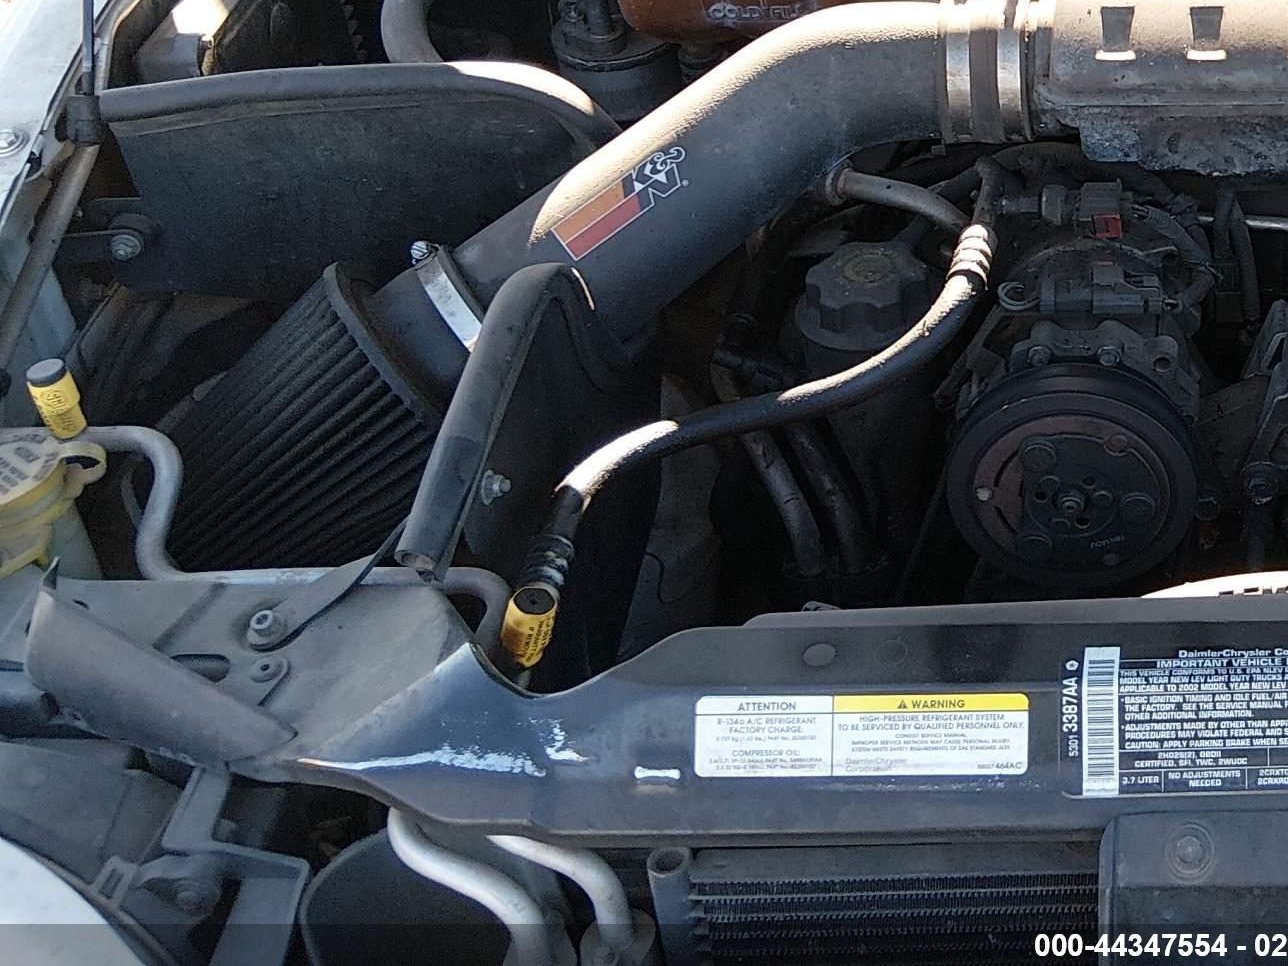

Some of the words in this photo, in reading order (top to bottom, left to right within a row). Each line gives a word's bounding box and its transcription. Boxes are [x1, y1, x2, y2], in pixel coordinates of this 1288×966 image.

[1178, 648, 1272, 658] DaimlerChrysler
[1156, 659, 1229, 668] IMPORTANT
[1231, 657, 1283, 666] VEHICLE
[1139, 668, 1170, 676] VEHICLE
[1120, 677, 1147, 685] MODEL
[1148, 676, 1169, 684] YEAR
[1120, 684, 1165, 693] APPLICABLE
[1166, 684, 1176, 692] TO
[1178, 683, 1199, 691] 2002
[1200, 683, 1227, 691] MODEL
[1229, 682, 1250, 690] YEAR
[1271, 681, 1286, 689] LEV
[1124, 696, 1148, 704] BASIC
[1149, 695, 1183, 703] IGNITION
[1252, 692, 1287, 701] FUEL/AIR
[737, 702, 797, 712] ATTENTION
[912, 699, 966, 709] WARNING
[1062, 676, 1079, 732] 3387AA
[1124, 704, 1140, 712] THE
[1199, 702, 1214, 710] THE
[1215, 701, 1248, 709] SERVICE
[1249, 700, 1283, 709] MANUAL
[765, 716, 817, 725] REFRIGERANT
[922, 714, 974, 722] REFRIGERANT
[975, 713, 1005, 721] SYSTEM
[1124, 712, 1151, 721] OTHER
[1152, 711, 1198, 720] ADDITIONAL
[1199, 710, 1255, 719] INFORMATION.
[729, 726, 766, 734] FACTORY
[851, 723, 860, 731] BE
[862, 723, 900, 731] SERVICED
[914, 722, 954, 730] QUALIFIED
[956, 721, 1001, 730] PERSONNEL
[1003, 721, 1025, 729] ONLY.
[1125, 722, 1181, 731] ADJUSTMENTS
[1183, 722, 1207, 730] MADE
[1208, 721, 1219, 729] BY
[1220, 721, 1246, 729] OTHER
[1247, 720, 1269, 728] THAN
[1125, 731, 1176, 740] PROCEDURES
[1197, 730, 1229, 738] VIOLATE
[1230, 729, 1264, 737] FEDERAL
[1265, 728, 1283, 736] AND
[1068, 735, 1079, 757] 5301
[1163, 740, 1188, 749] APPLY
[1189, 739, 1224, 748] PARKING
[1225, 738, 1251, 747] BRAKE
[1252, 737, 1277, 746] WHEN
[732, 749, 784, 757] COMPRESSOR
[995, 762, 1022, 770] 464AC
[1168, 771, 1181, 779] NO
[1183, 770, 1241, 779] ADJUSTMENTS
[1121, 776, 1136, 785] 3.7
[1137, 775, 1160, 784] LITER
[1189, 778, 1222, 787] NEEDED
